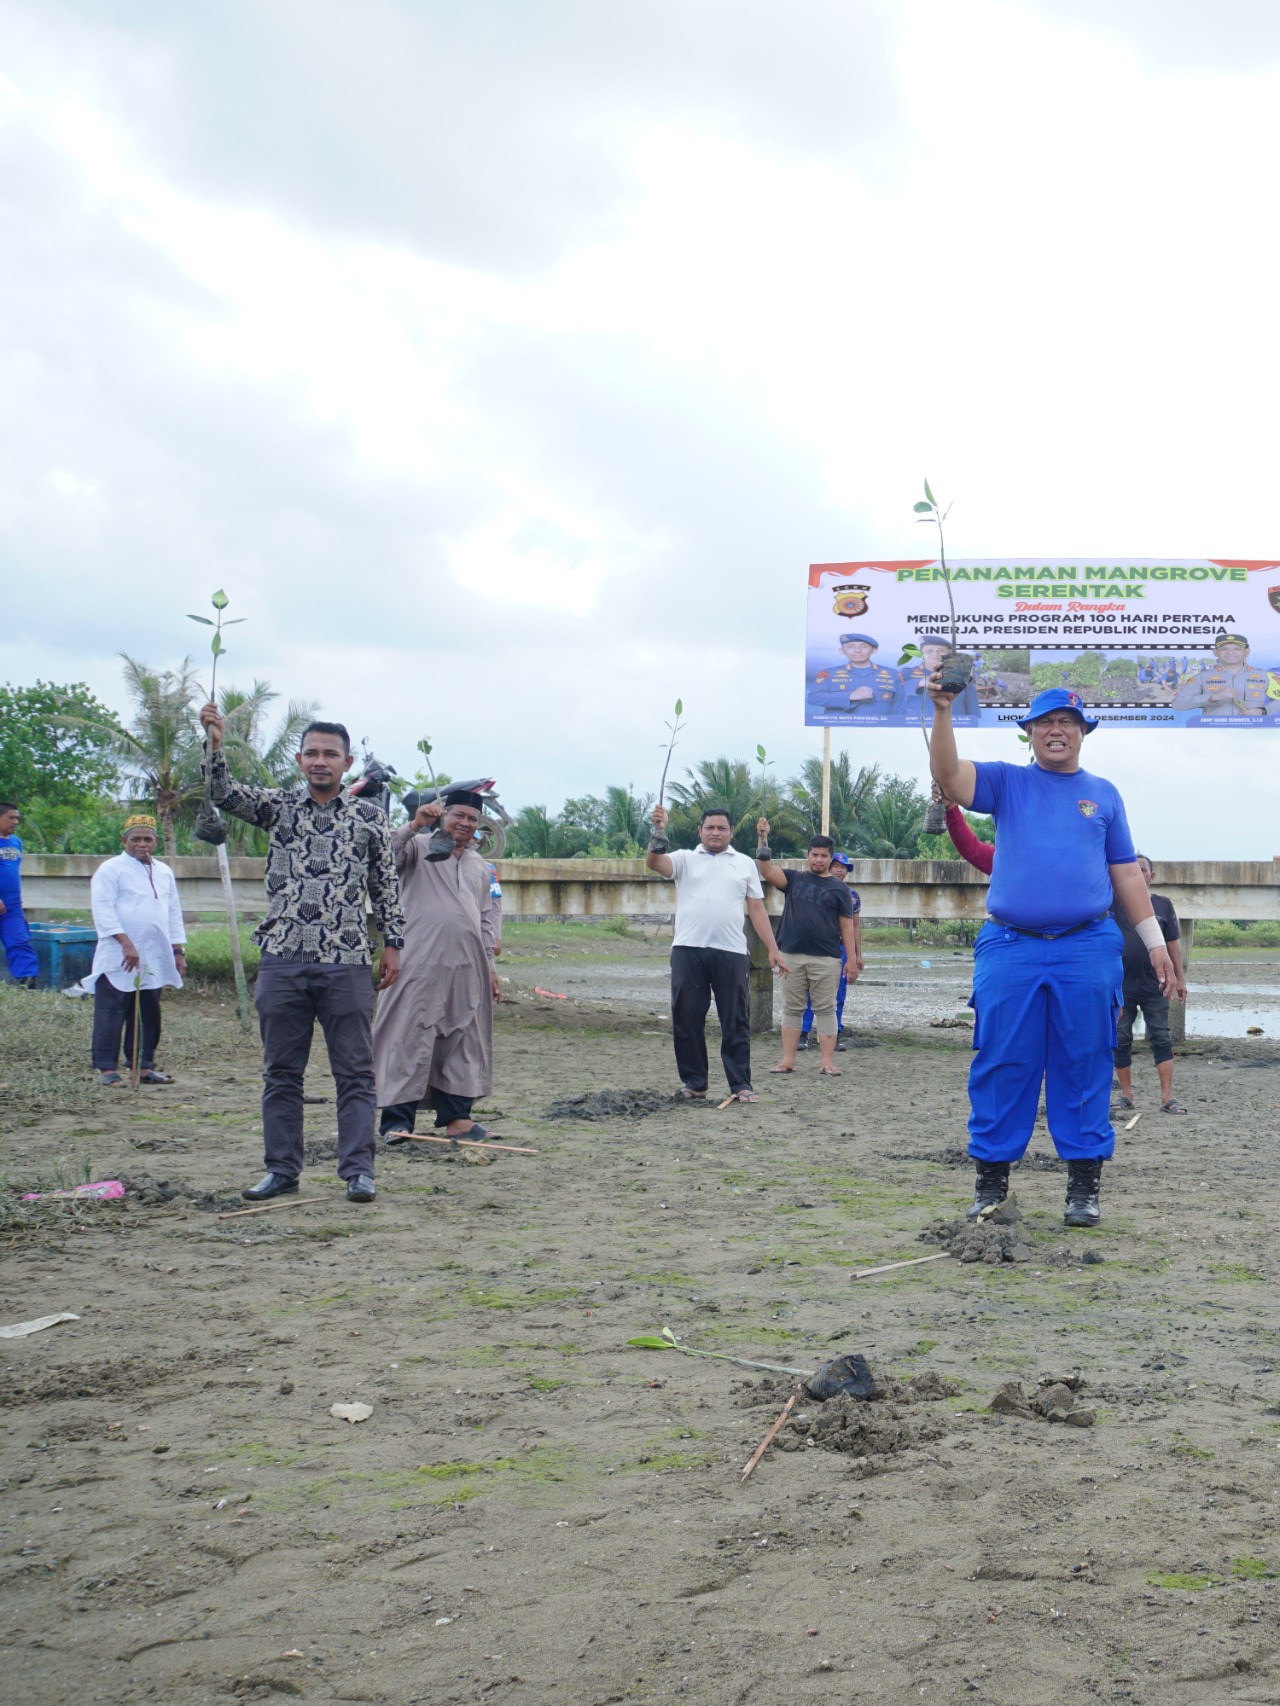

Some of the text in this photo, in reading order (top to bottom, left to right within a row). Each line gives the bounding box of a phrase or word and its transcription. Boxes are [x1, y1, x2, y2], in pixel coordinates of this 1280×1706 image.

[897, 566, 1247, 582] PENANAMAN MANGROVE
[997, 584, 1145, 598] SERENTAK
[1014, 601, 1126, 613] Dalam Rangka
[1008, 614, 1085, 623] PROGRAM
[1090, 614, 1116, 623] 100
[1121, 614, 1158, 623] HARI
[1162, 614, 1236, 623] PERTAMA
[914, 626, 1228, 634] KINERJA PRESIDEN REPUBLIK INDONESIA
